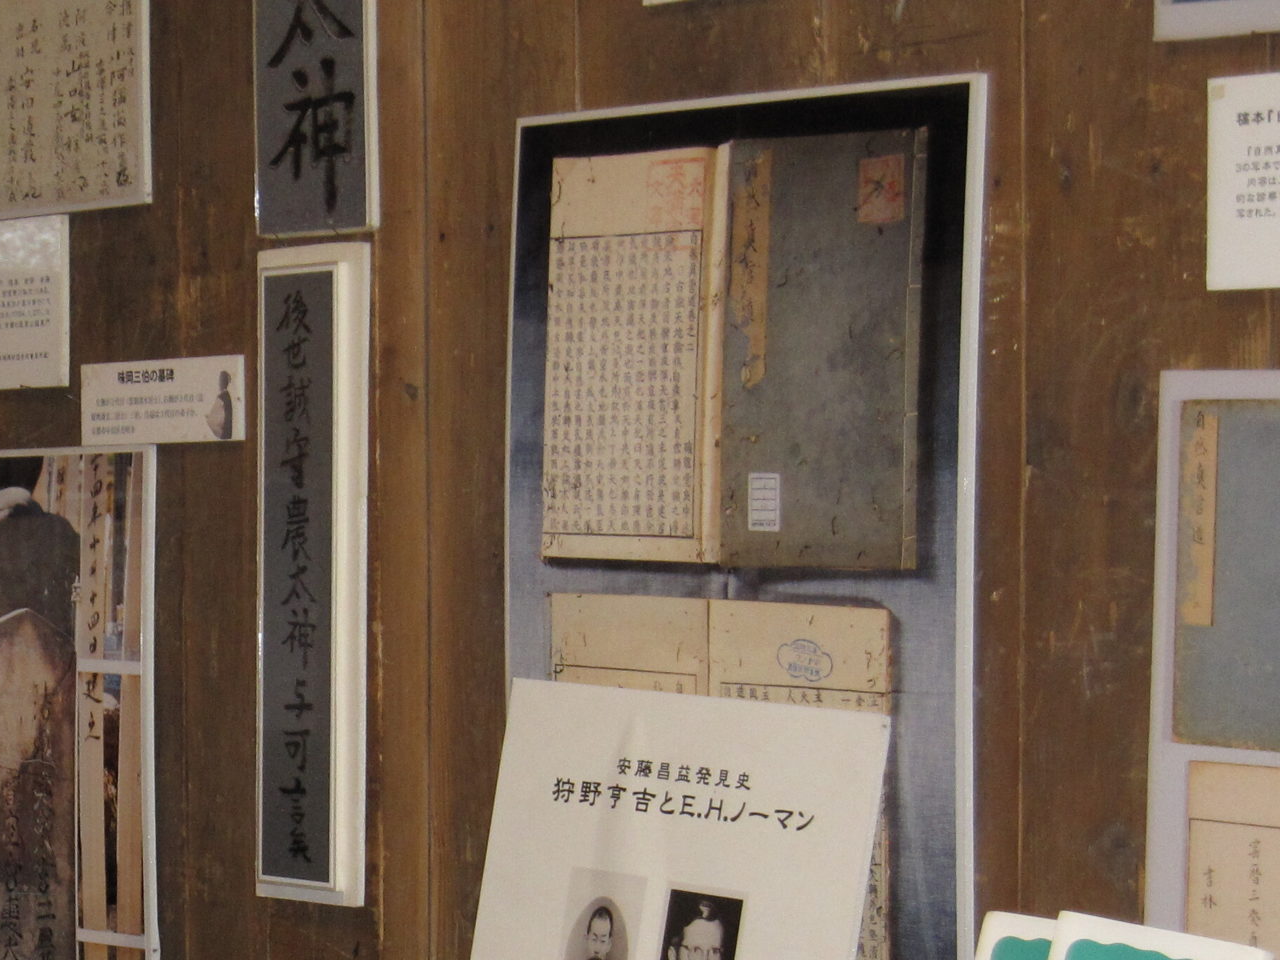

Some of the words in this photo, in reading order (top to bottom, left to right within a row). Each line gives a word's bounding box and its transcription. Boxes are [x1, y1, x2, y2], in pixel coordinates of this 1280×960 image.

[616, 757, 751, 790] 安藤昌益発見史
[552, 776, 816, 832] 狩野亨吉とE.H.ノーマン
